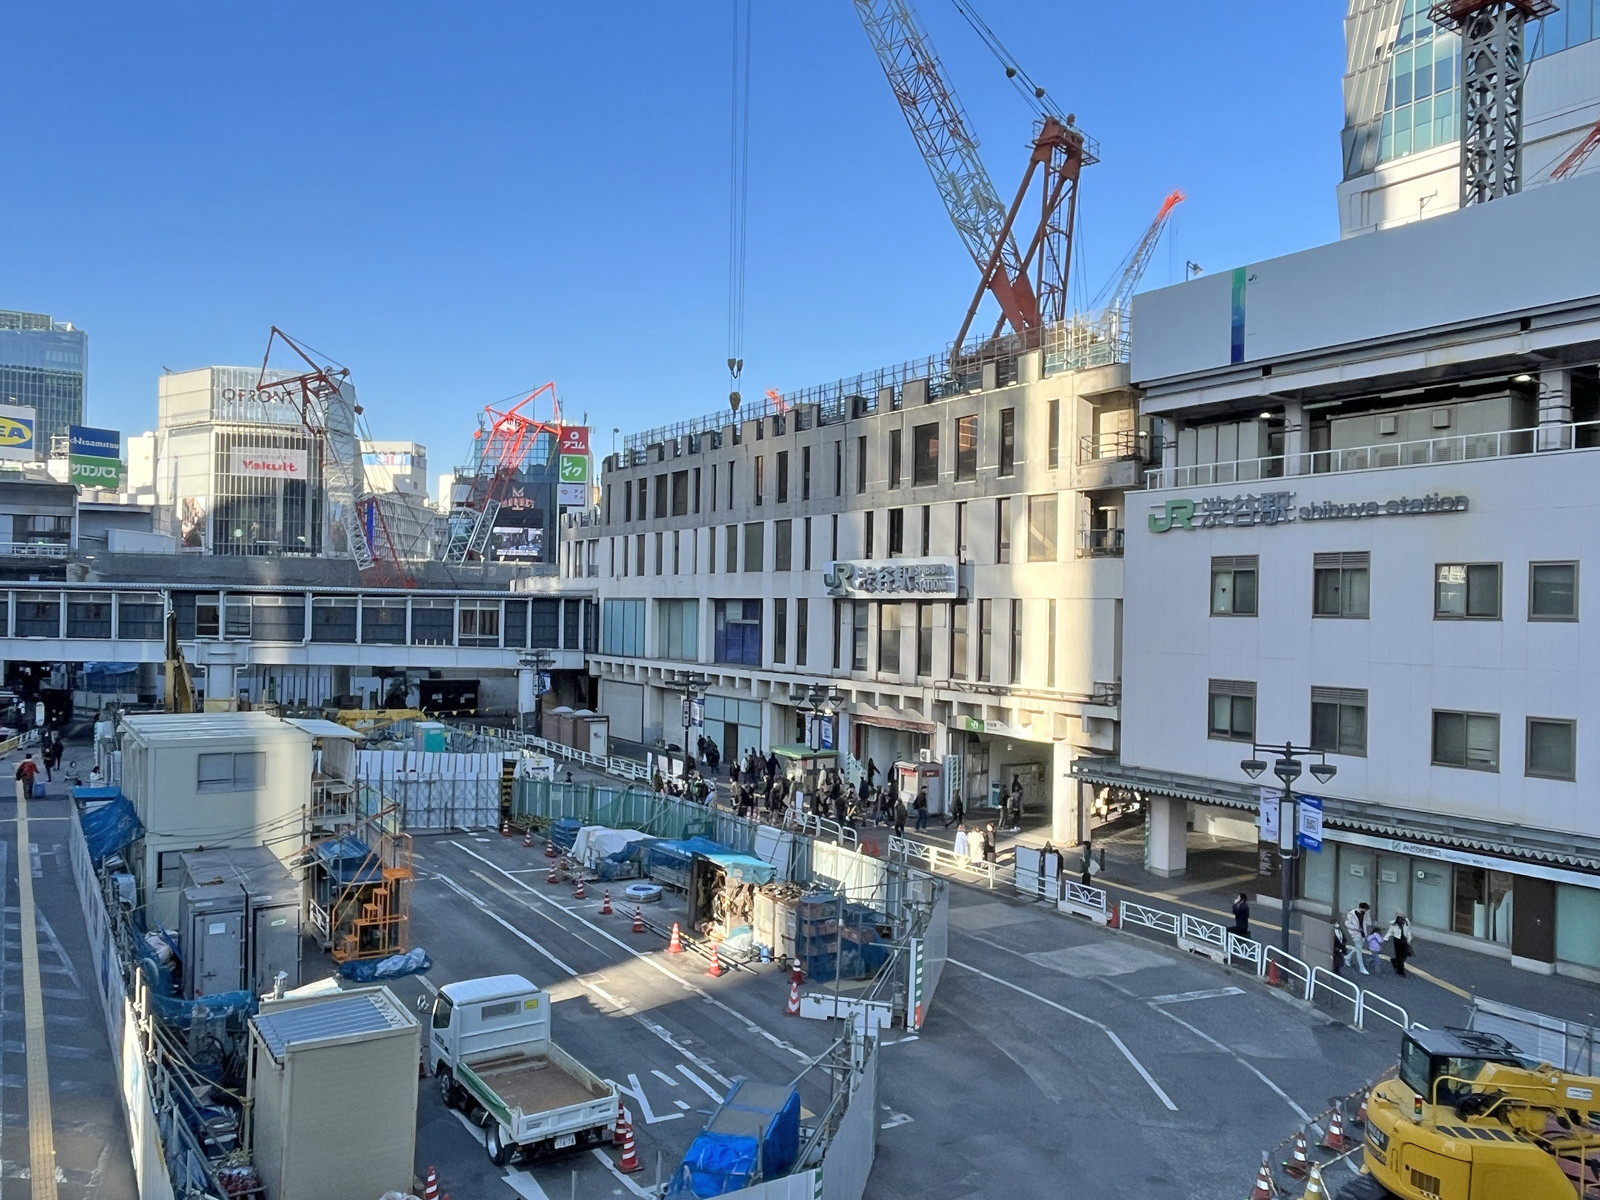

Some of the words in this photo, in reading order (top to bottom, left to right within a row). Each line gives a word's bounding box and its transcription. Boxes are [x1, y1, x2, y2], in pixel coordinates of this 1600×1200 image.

[70, 436, 119, 449] Hisamitsu
[563, 440, 586, 449] アコム
[72, 463, 117, 479] サロンパス
[242, 460, 298, 472] Yakult
[1148, 498, 1196, 533] JR
[1202, 491, 1295, 527] 渋谷駅
[1299, 500, 1378, 521] shibuya
[1387, 494, 1469, 514] station
[824, 563, 853, 590] JR
[858, 564, 914, 593] 渋谷駅
